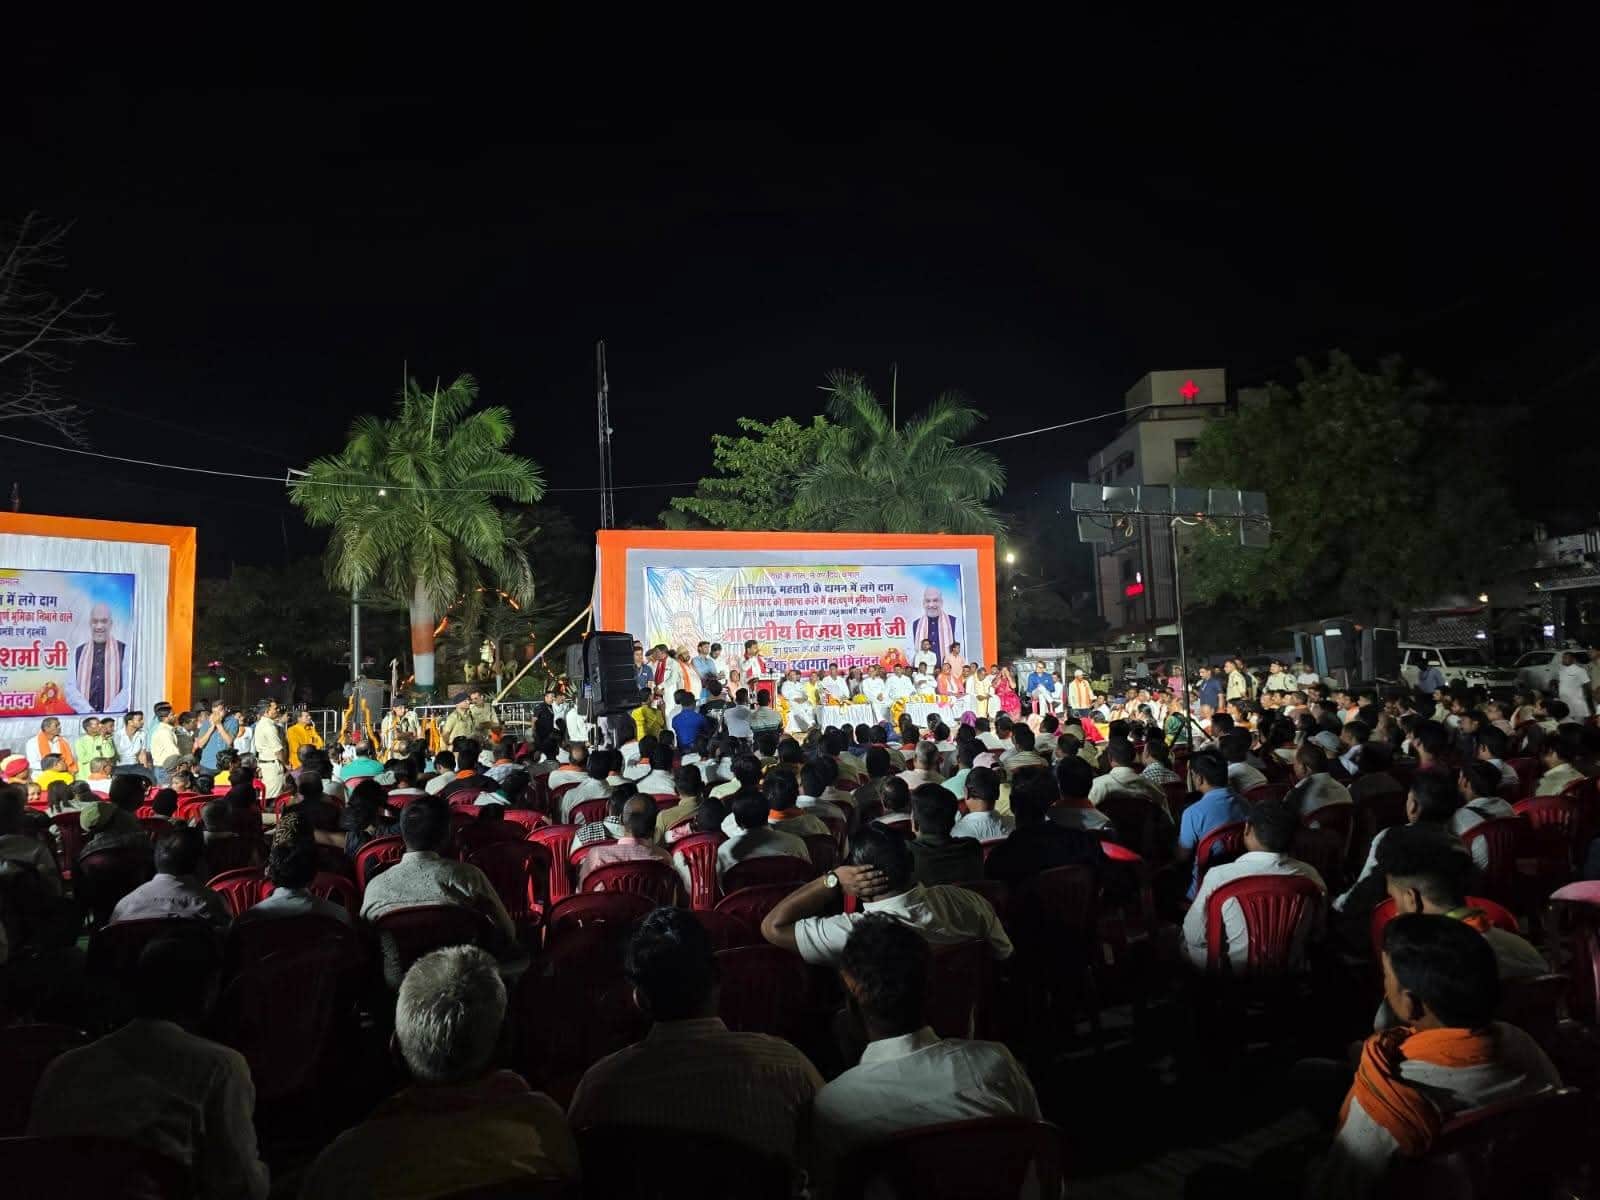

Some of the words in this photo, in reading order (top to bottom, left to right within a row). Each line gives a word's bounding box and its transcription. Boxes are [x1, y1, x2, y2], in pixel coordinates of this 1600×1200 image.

[780, 583, 810, 595] महतारी
[813, 584, 822, 594] के
[825, 583, 847, 593] दामन
[850, 582, 858, 593] में
[860, 582, 875, 593] लगे
[878, 583, 894, 593] दाग
[7, 592, 16, 606] में
[18, 593, 36, 607] लगे
[39, 595, 58, 607] दाग
[11, 609, 34, 624] भूमिका
[723, 620, 792, 642] माननीय
[796, 619, 842, 640] विजय
[847, 617, 881, 638] शर्मा
[885, 616, 906, 637] जी
[0, 640, 41, 668] शर्मा
[44, 640, 69, 668] जी
[792, 658, 829, 671] स्वागत
